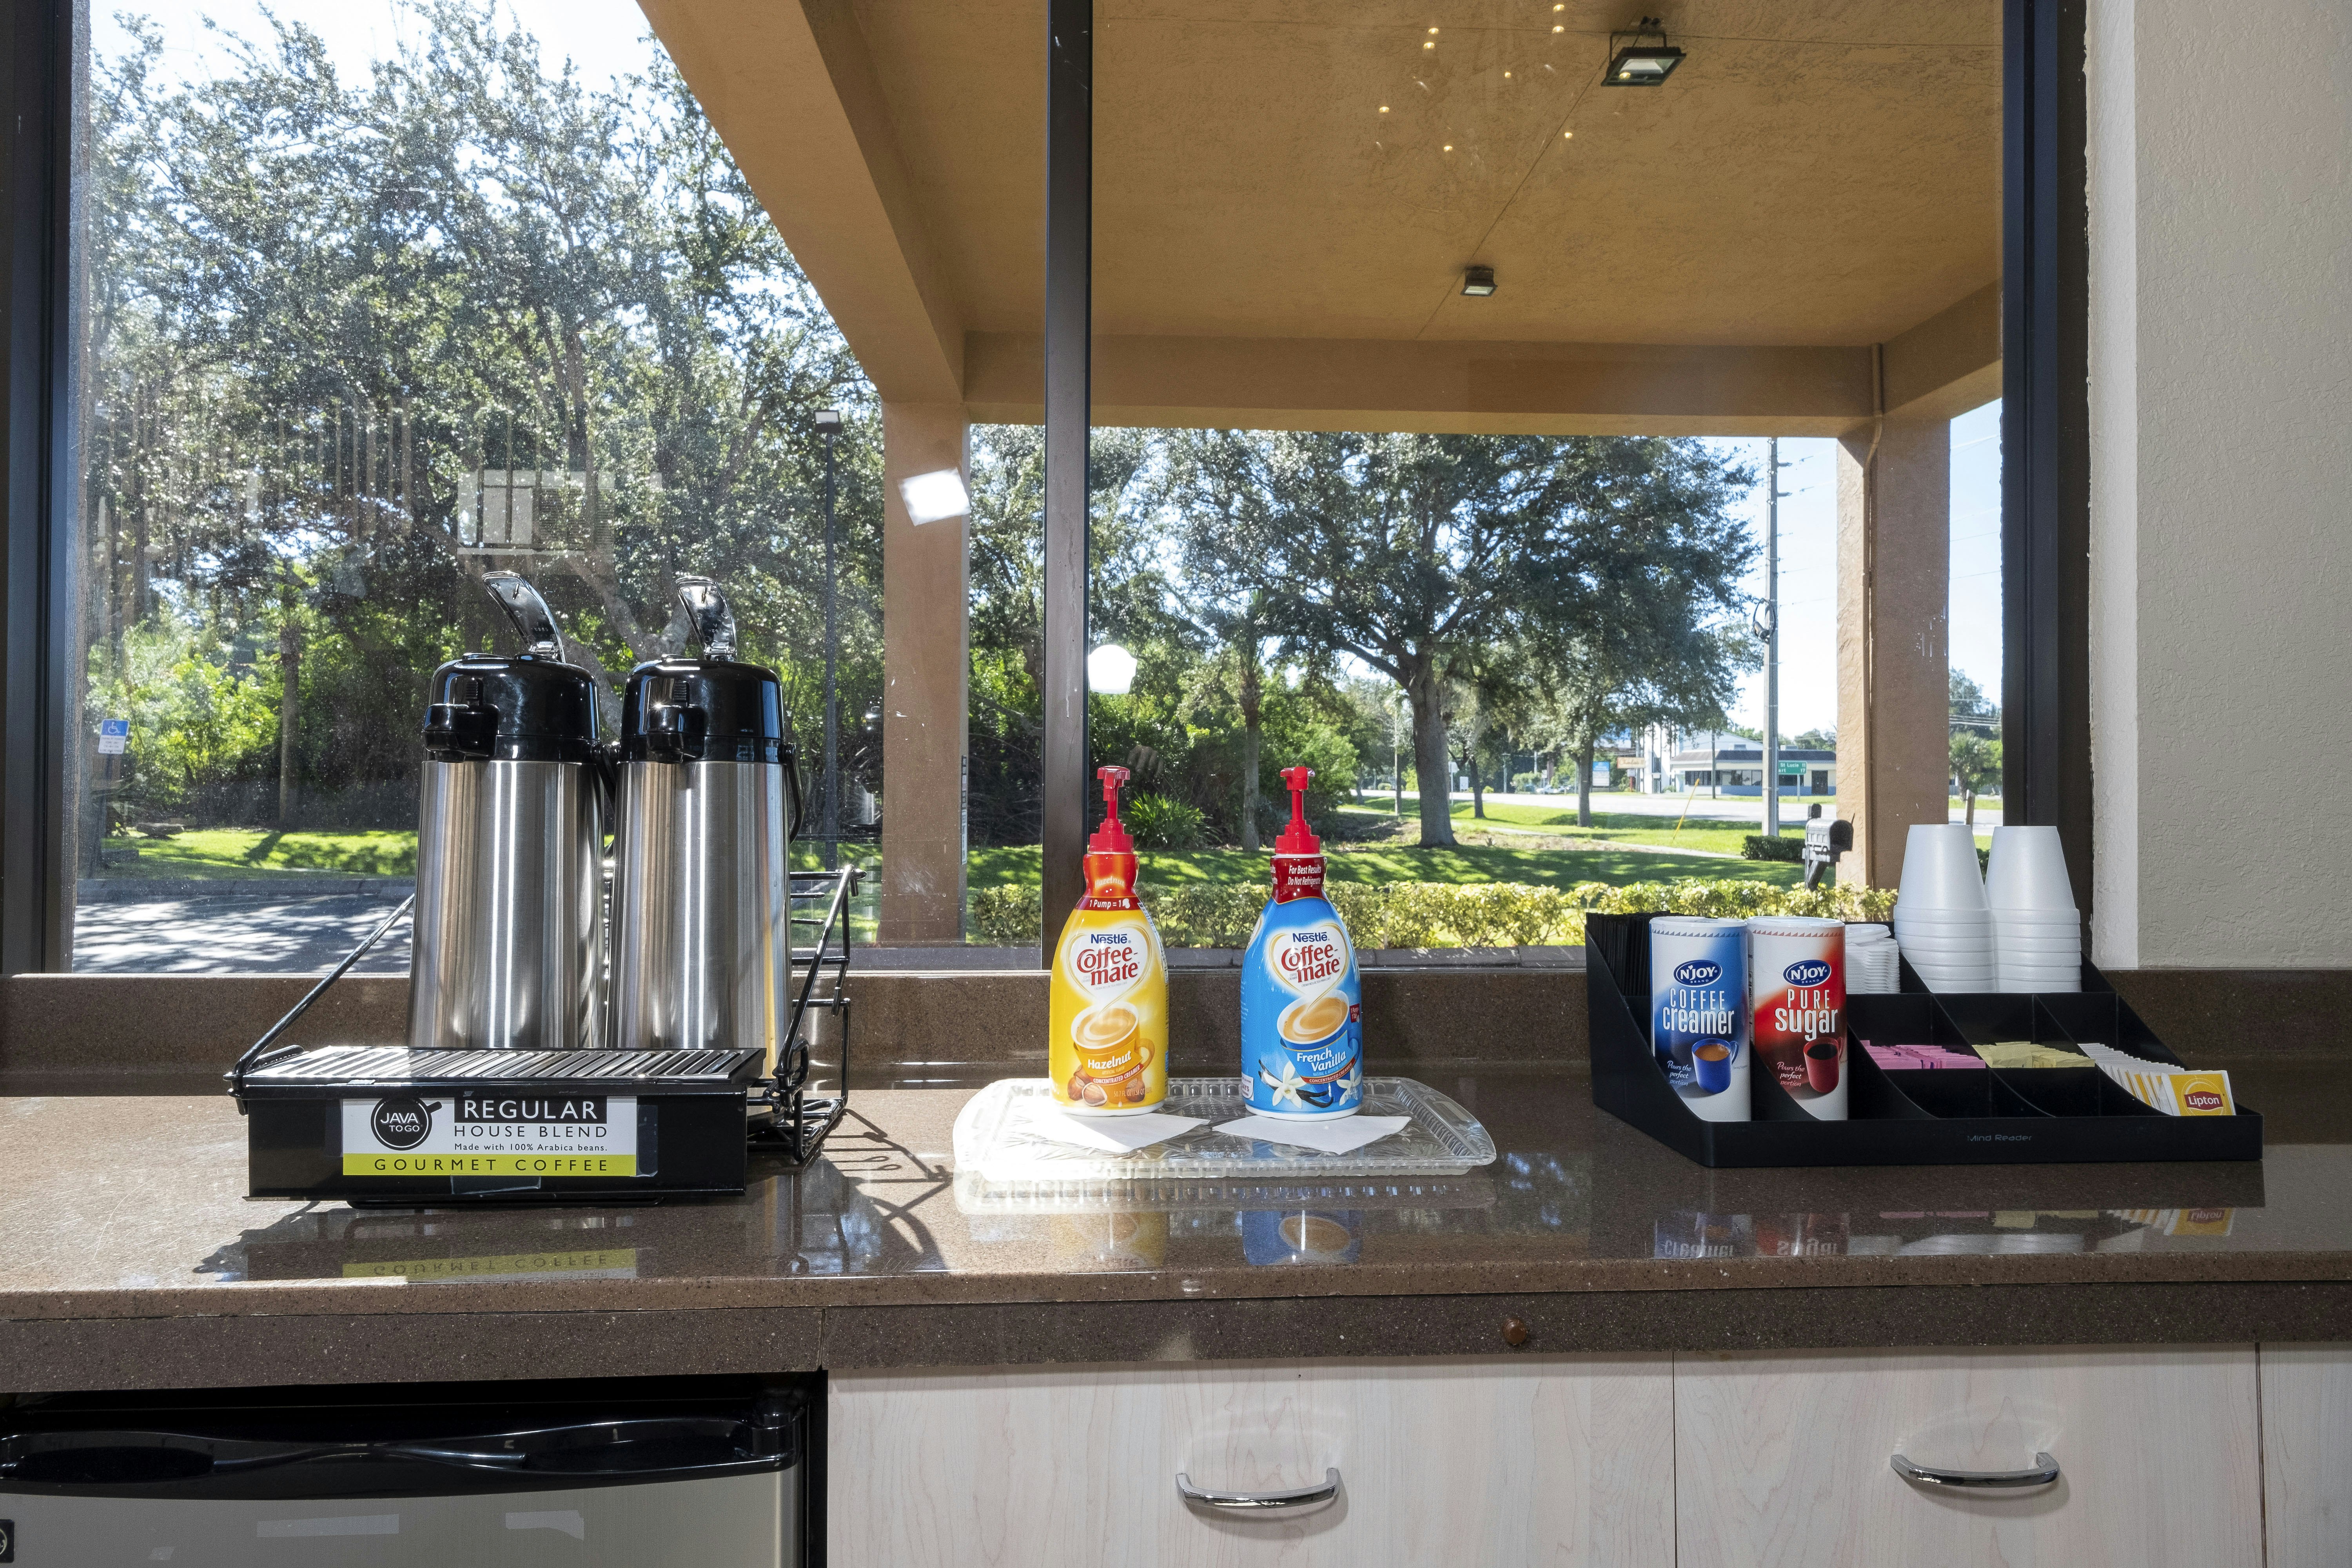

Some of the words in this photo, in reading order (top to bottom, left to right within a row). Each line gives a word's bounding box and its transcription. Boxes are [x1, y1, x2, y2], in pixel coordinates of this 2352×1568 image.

[1289, 865, 1297, 874] For
[1297, 865, 1308, 874] Best
[1308, 864, 1321, 874] Results
[1094, 875, 1125, 888] Hazelnut
[1288, 877, 1294, 885] Do
[1294, 877, 1302, 885] Not
[1302, 876, 1321, 887] Refrigerate
[1093, 900, 1111, 910] Pump
[1091, 934, 1127, 944] Nestlé
[1292, 932, 1327, 942] Nestlé
[1091, 962, 1138, 985] mate
[1297, 958, 1340, 983] mate
[1670, 987, 1725, 1010] COFFEE
[1787, 989, 1829, 1009] PURE
[1662, 1006, 1734, 1034] creamer
[1775, 1007, 1838, 1042] sugar
[1087, 1050, 1132, 1070] Hazelnut
[1297, 1047, 1333, 1062] French
[1311, 1051, 1347, 1072] Vanilla
[1667, 1060, 1682, 1070] Pours
[1777, 1062, 1794, 1071] Pours
[1093, 1075, 1123, 1084] CONCENTRATED
[1124, 1064, 1140, 1079] CREAMER
[1309, 1073, 1339, 1083] CONCENTRATED
[1339, 1062, 1352, 1077] CREAMER
[1780, 1071, 1802, 1080] perfect
[2188, 1096, 2220, 1107] Lipton
[464, 1100, 597, 1119] REGULAR
[380, 1112, 419, 1124] JAVA
[454, 1125, 525, 1137] HOUSE
[539, 1126, 607, 1138] BLEND
[510, 1143, 534, 1151] 100%
[578, 1143, 608, 1152] beans.
[374, 1159, 496, 1171] GOURMET
[515, 1159, 607, 1171] COFFEE
